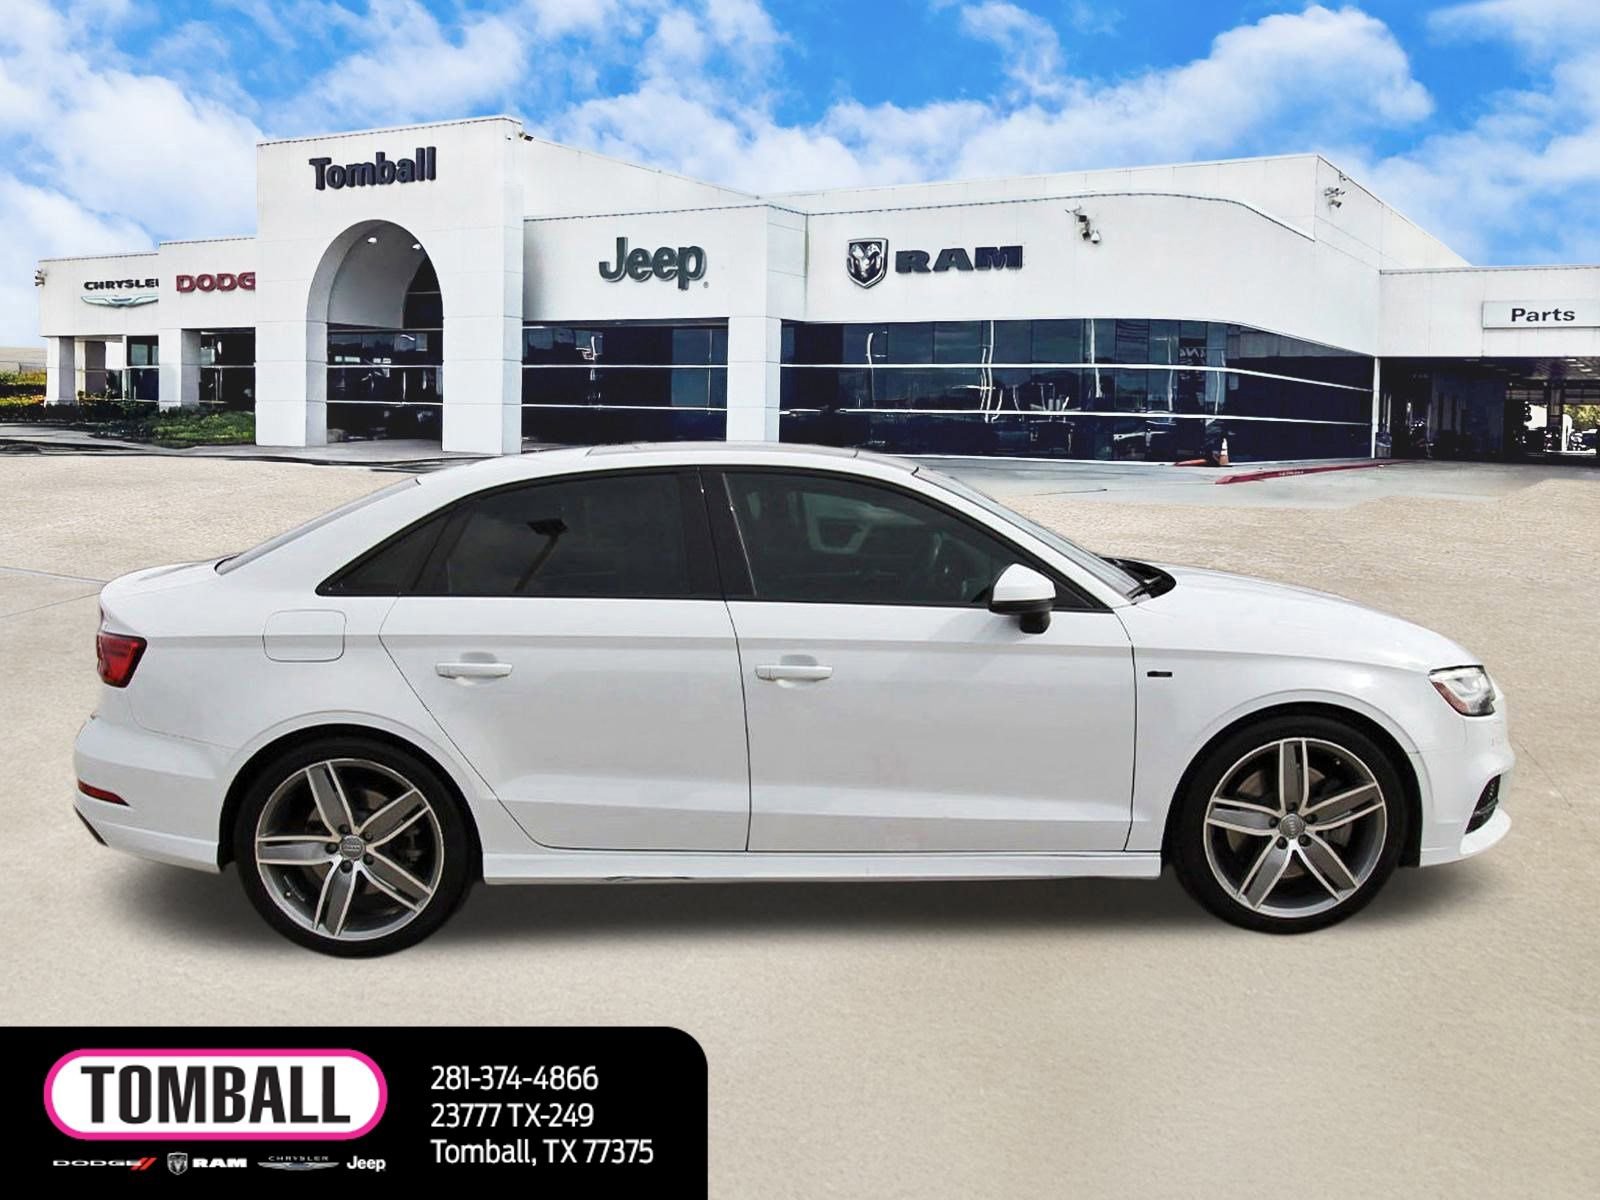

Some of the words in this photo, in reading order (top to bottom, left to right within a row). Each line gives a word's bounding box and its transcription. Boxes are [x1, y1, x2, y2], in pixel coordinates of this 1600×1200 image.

[309, 146, 436, 191] Tomball
[599, 237, 707, 291] Jeep
[895, 246, 1023, 273] RAM
[84, 279, 159, 290] CHRYSLE
[1511, 308, 1575, 322] Parts
